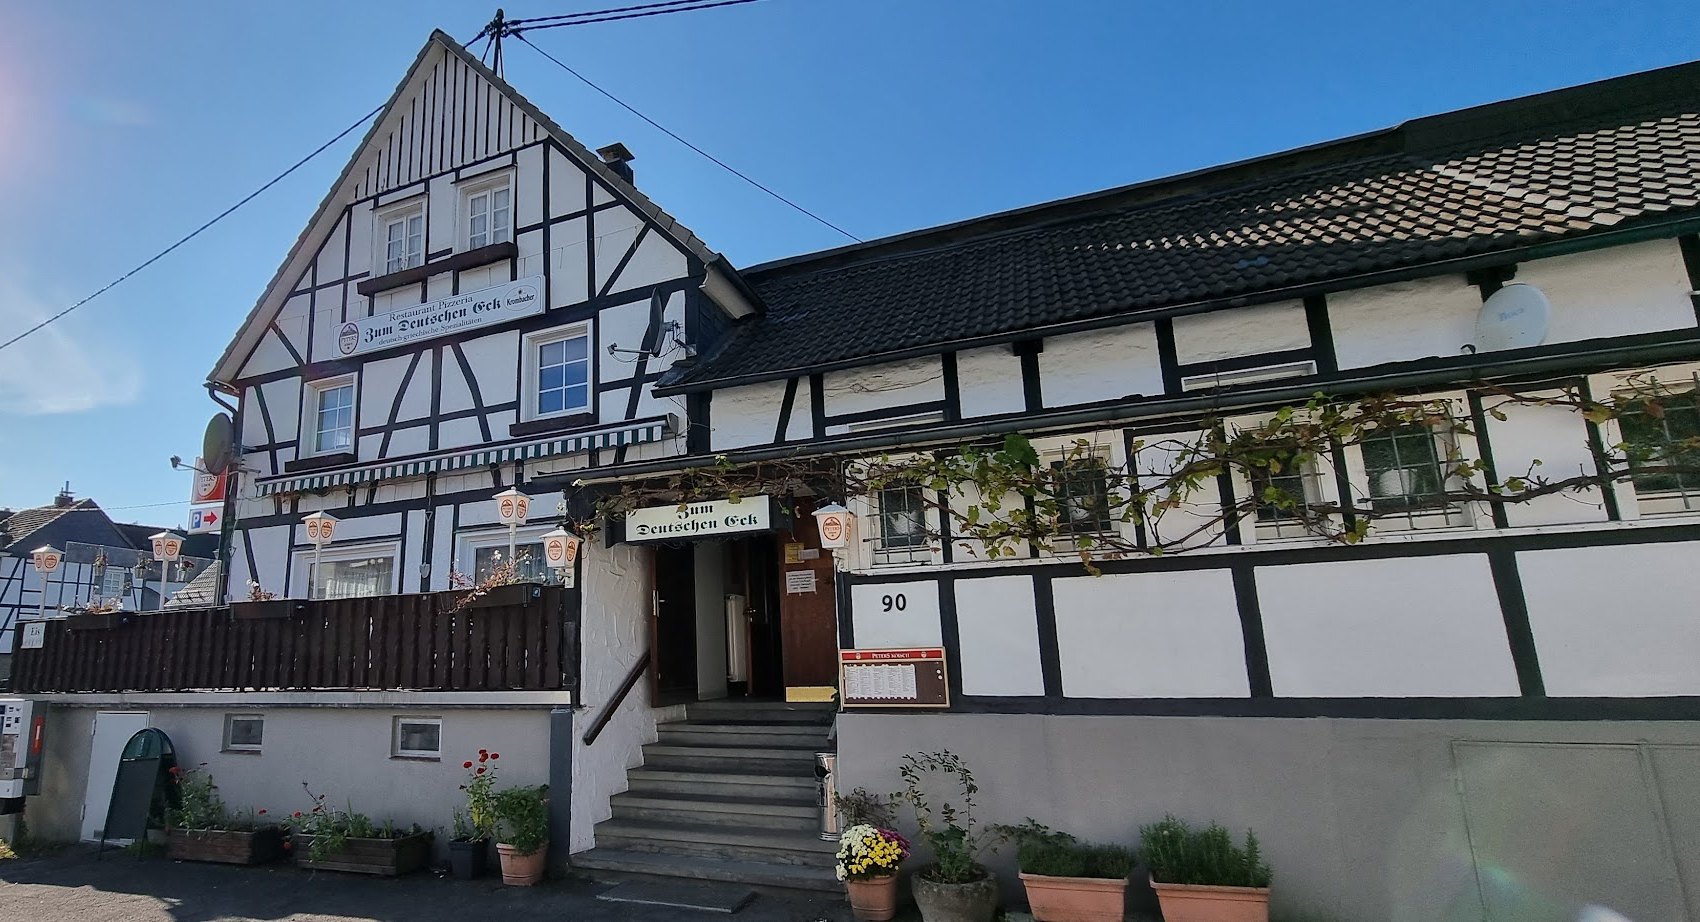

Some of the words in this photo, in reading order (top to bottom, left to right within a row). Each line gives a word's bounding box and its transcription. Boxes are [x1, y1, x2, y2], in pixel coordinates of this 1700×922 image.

[389, 305, 435, 322] Restaurant
[438, 295, 473, 310] Pizzeria
[506, 294, 535, 306] Krombacher
[364, 326, 393, 343] Zum
[398, 308, 467, 332] Deutschen
[472, 298, 501, 314] Eck
[440, 317, 482, 333] Spezialitäten
[636, 519, 717, 535] Deutschen
[724, 513, 758, 528] Eck
[882, 593, 907, 612] 90
